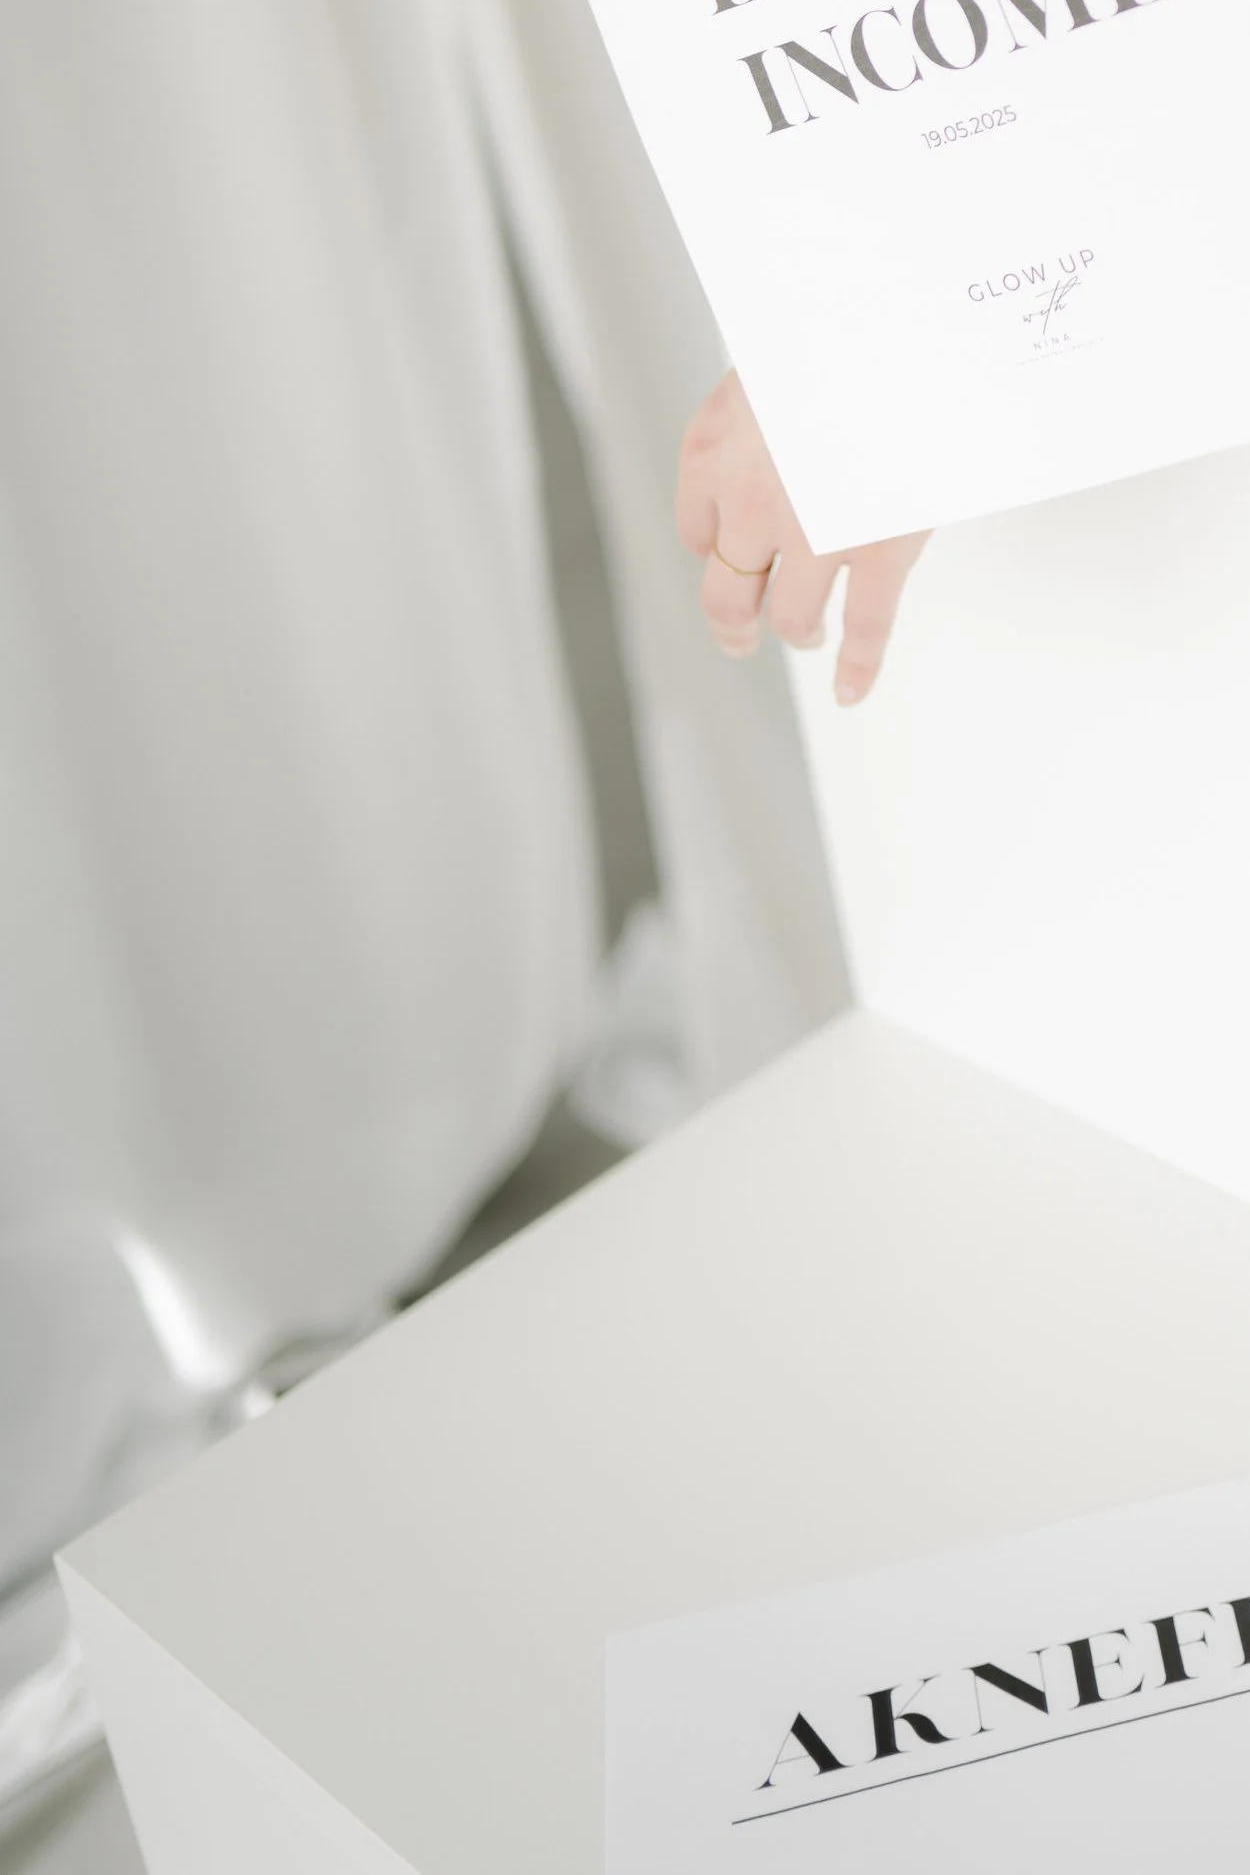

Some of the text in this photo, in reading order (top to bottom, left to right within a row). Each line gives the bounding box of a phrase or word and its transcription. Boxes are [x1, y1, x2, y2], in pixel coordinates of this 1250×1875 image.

[921, 104, 1018, 150] 19.05.2025
[967, 249, 1095, 302] GLOW UP
